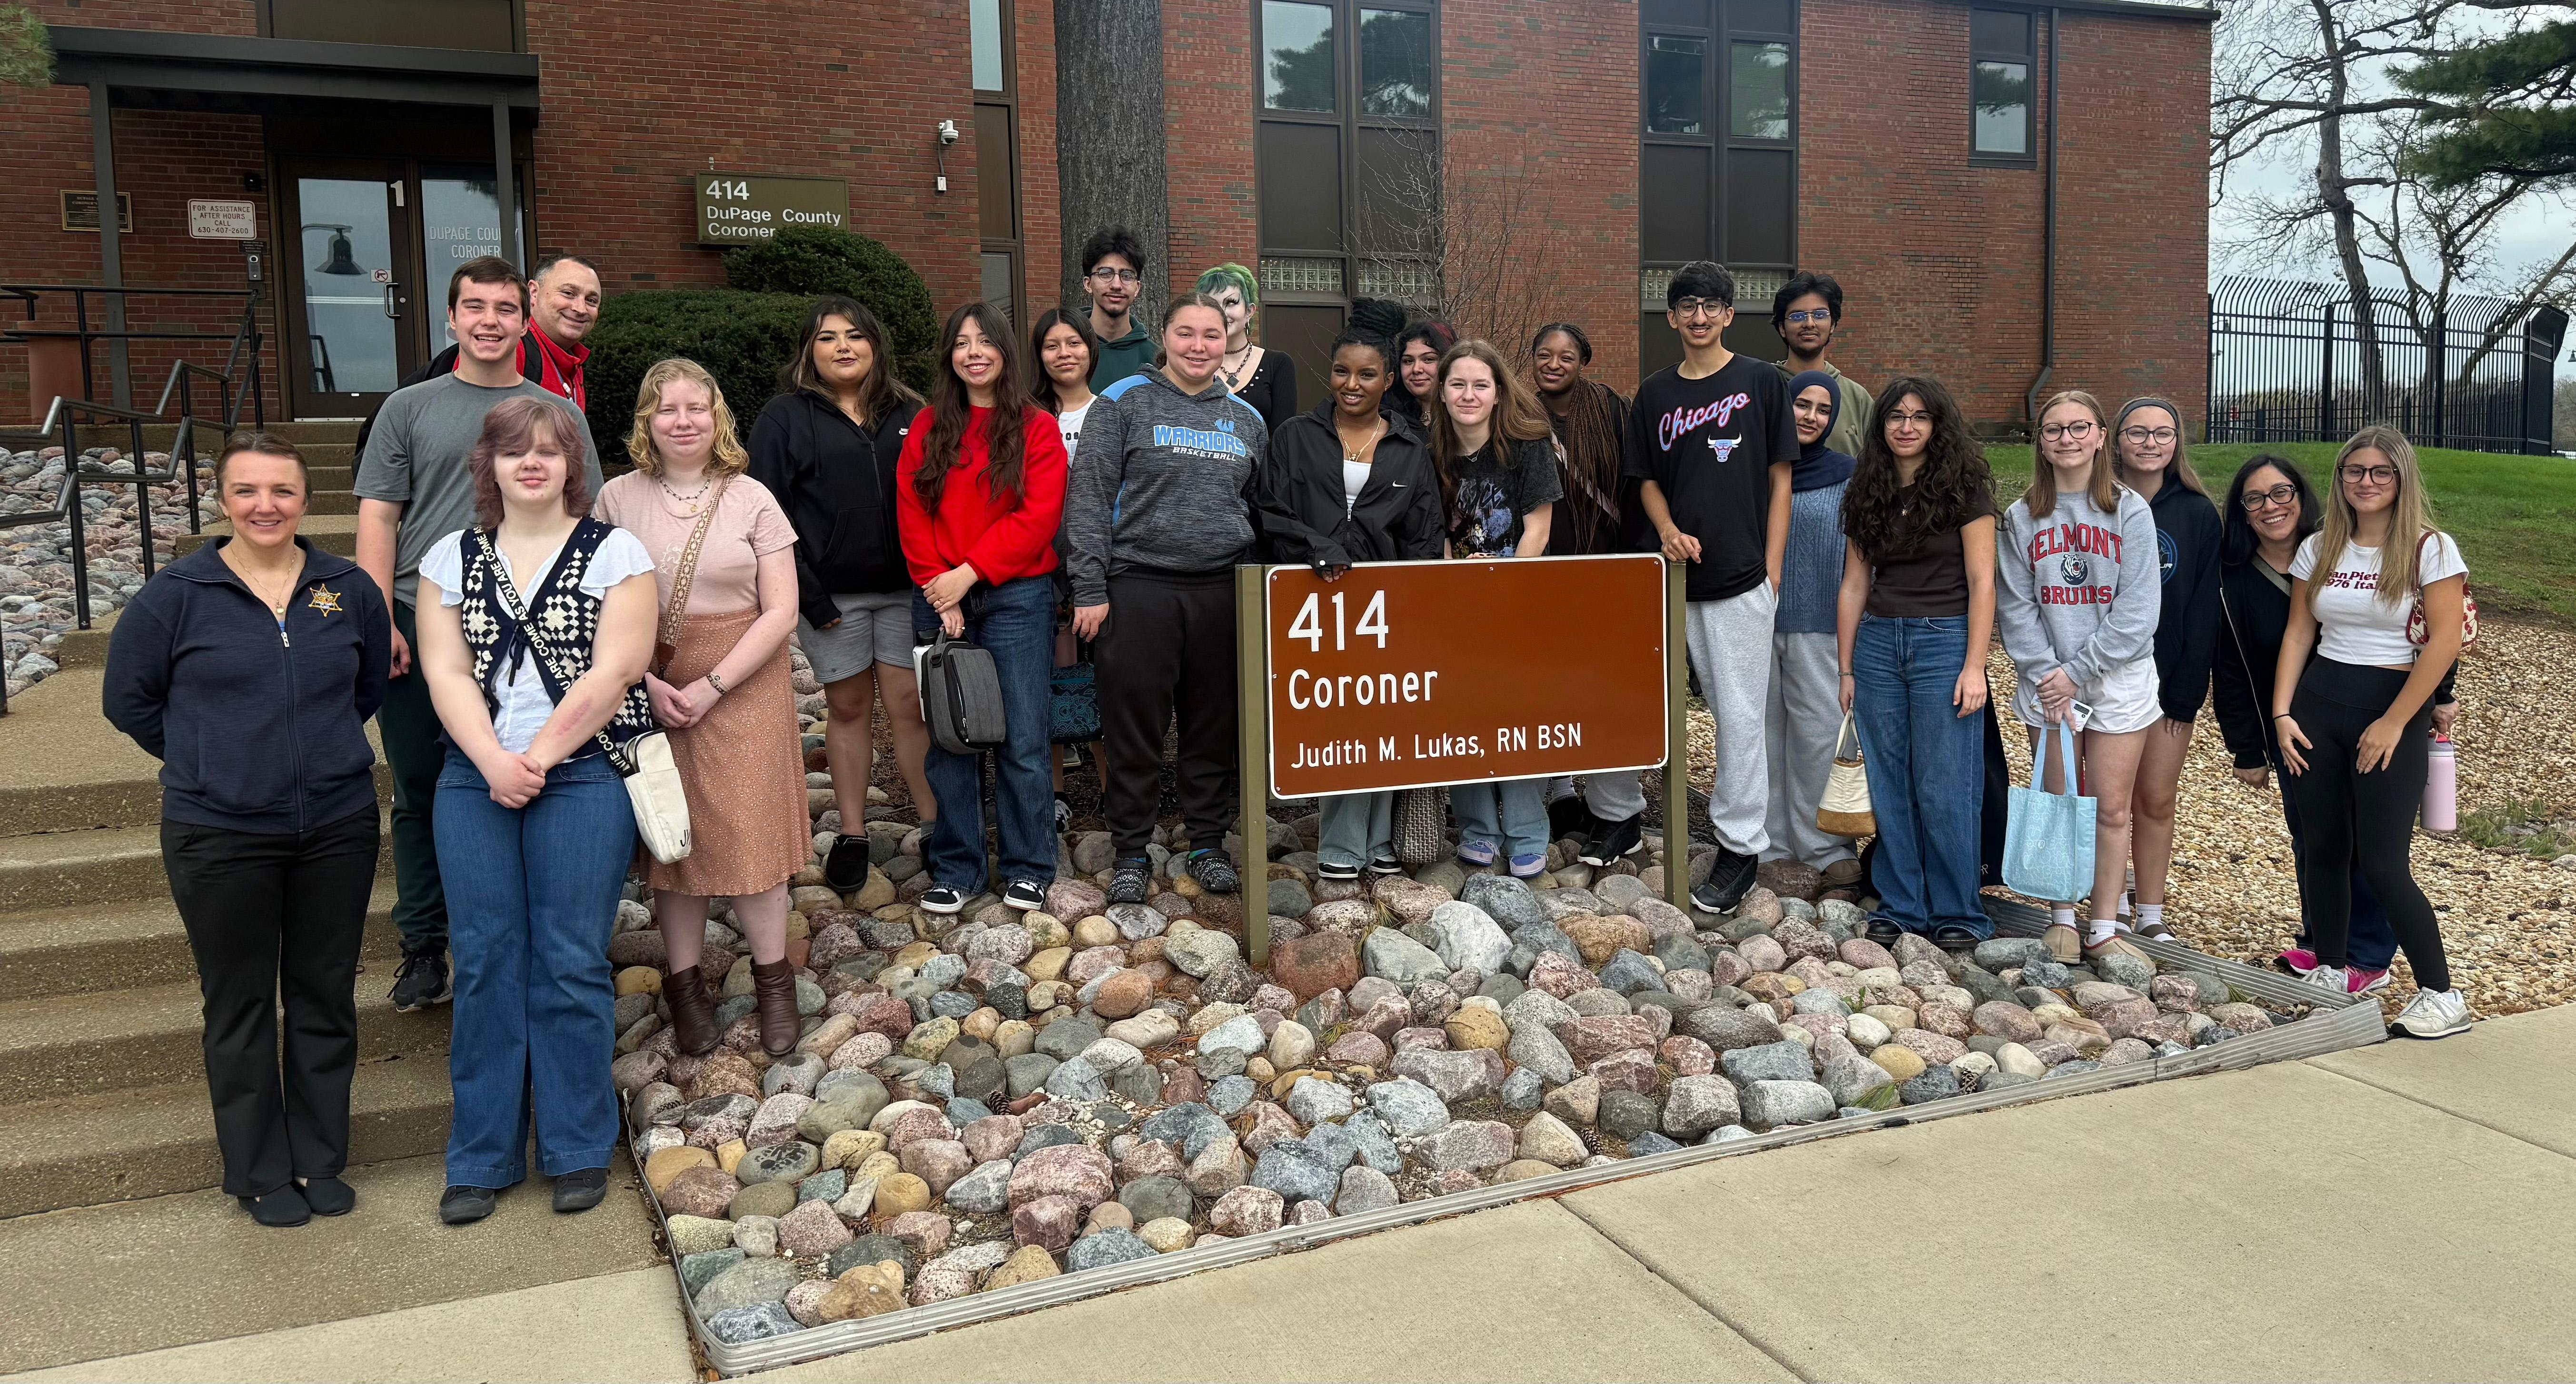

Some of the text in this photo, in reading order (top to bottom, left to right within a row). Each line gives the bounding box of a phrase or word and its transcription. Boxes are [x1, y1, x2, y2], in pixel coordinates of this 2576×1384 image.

[390, 180, 404, 207] 1
[706, 180, 750, 200] 414
[707, 206, 841, 227] DuPage County
[430, 227, 472, 240] DUPAGE
[708, 222, 776, 238] Coroner
[1658, 392, 1751, 451] Chicago
[1153, 425, 1246, 457] WARRIORS
[1172, 447, 1237, 461] BASKETBALL
[476, 533, 496, 562] COME
[490, 561, 509, 582] ARE
[2349, 571, 2379, 580] Piet
[2325, 578, 2350, 588] 976
[502, 583, 519, 607] YOU
[2041, 585, 2112, 605] BRUINS
[515, 606, 528, 621] AS
[1288, 590, 1389, 652] 414
[524, 621, 549, 657] COME
[545, 656, 566, 679] ARE
[1289, 669, 1438, 710] Coroner
[1291, 722, 1581, 768] Judith M. Lukas, RN BSN
